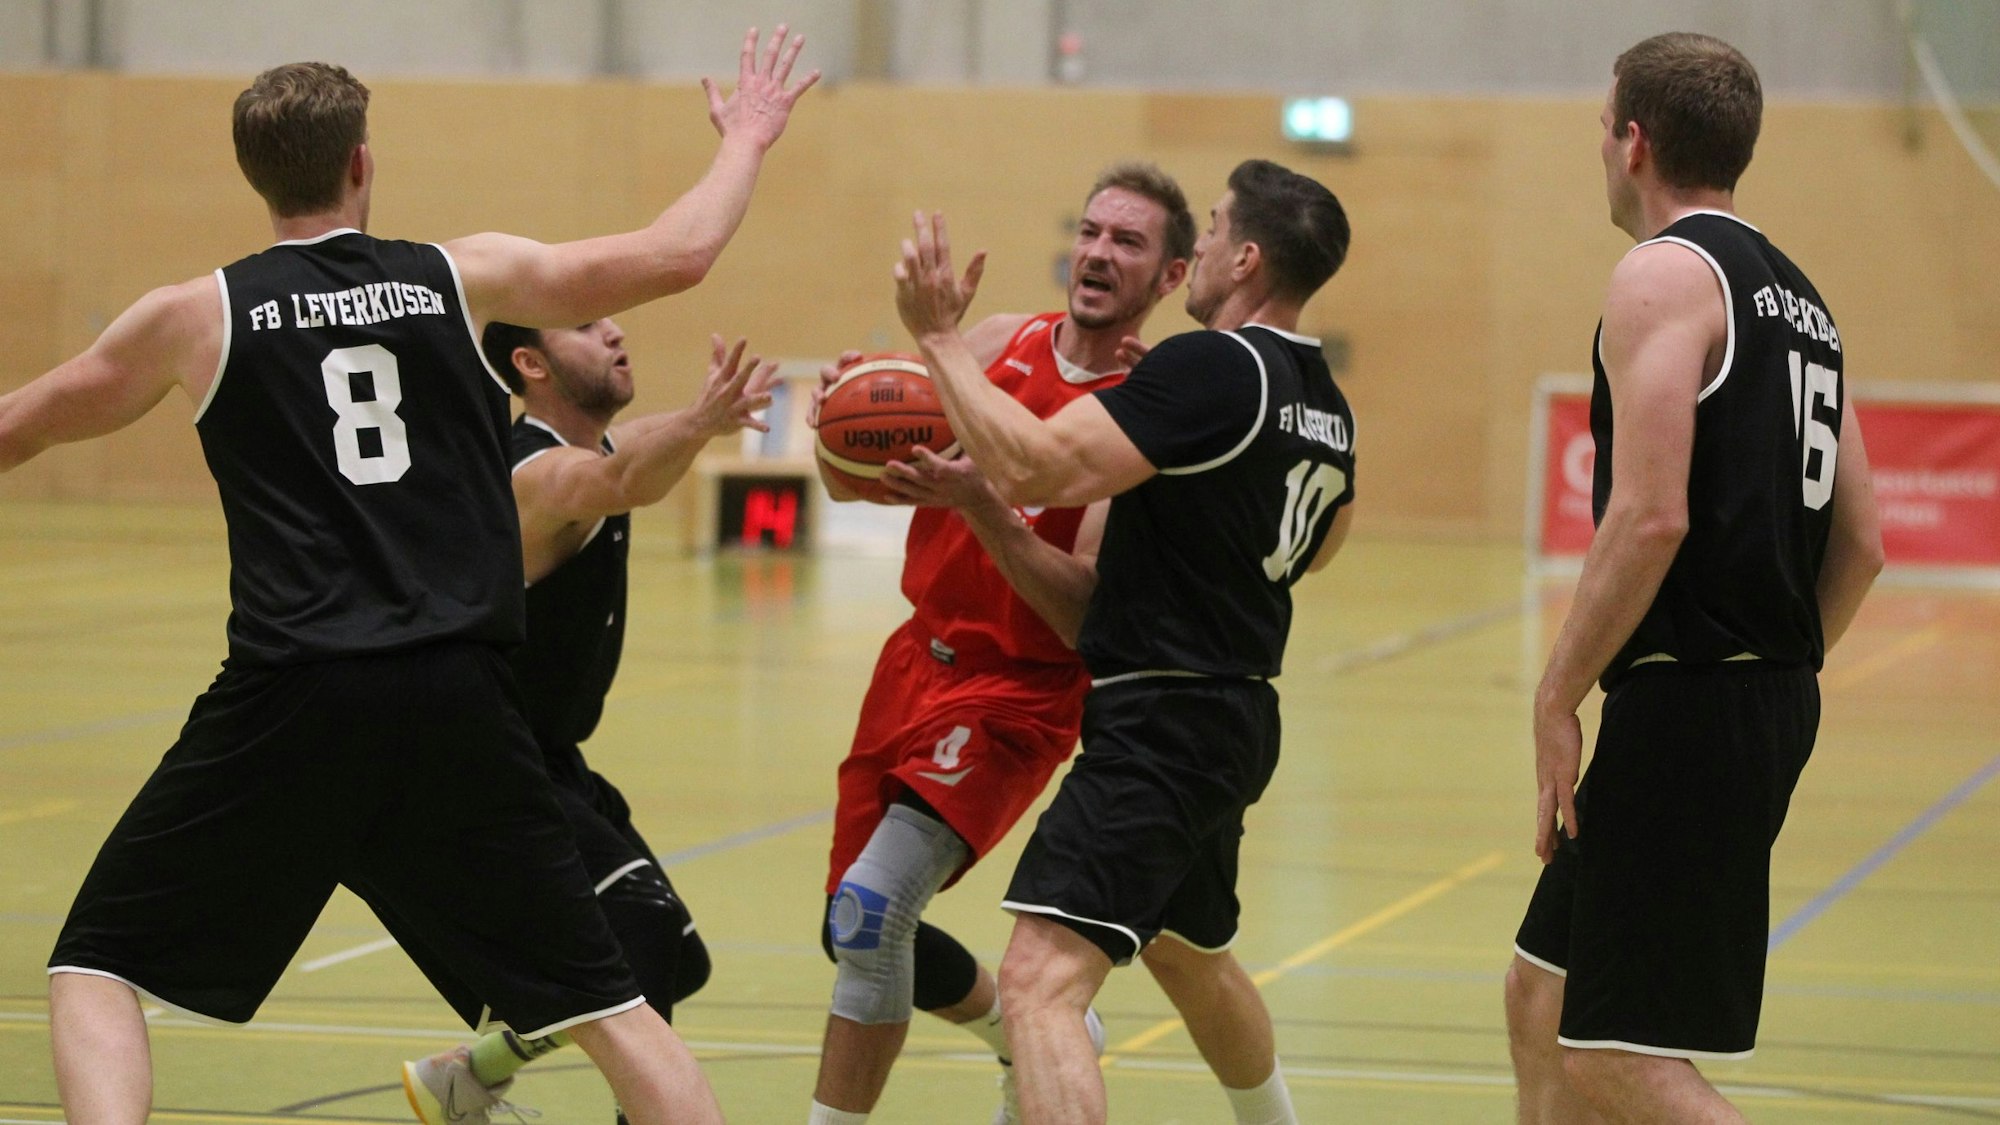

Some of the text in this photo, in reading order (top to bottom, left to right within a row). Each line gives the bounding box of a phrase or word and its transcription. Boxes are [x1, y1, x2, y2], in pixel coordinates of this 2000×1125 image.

[249, 281, 446, 331] FB LEVERKUSEN
[1753, 285, 1780, 317] FB
[320, 343, 412, 486] 8
[870, 388, 904, 404] FIBA
[843, 425, 933, 451] molten
[741, 489, 799, 549] 14
[1262, 459, 1347, 582] 10
[932, 725, 972, 769] 4
